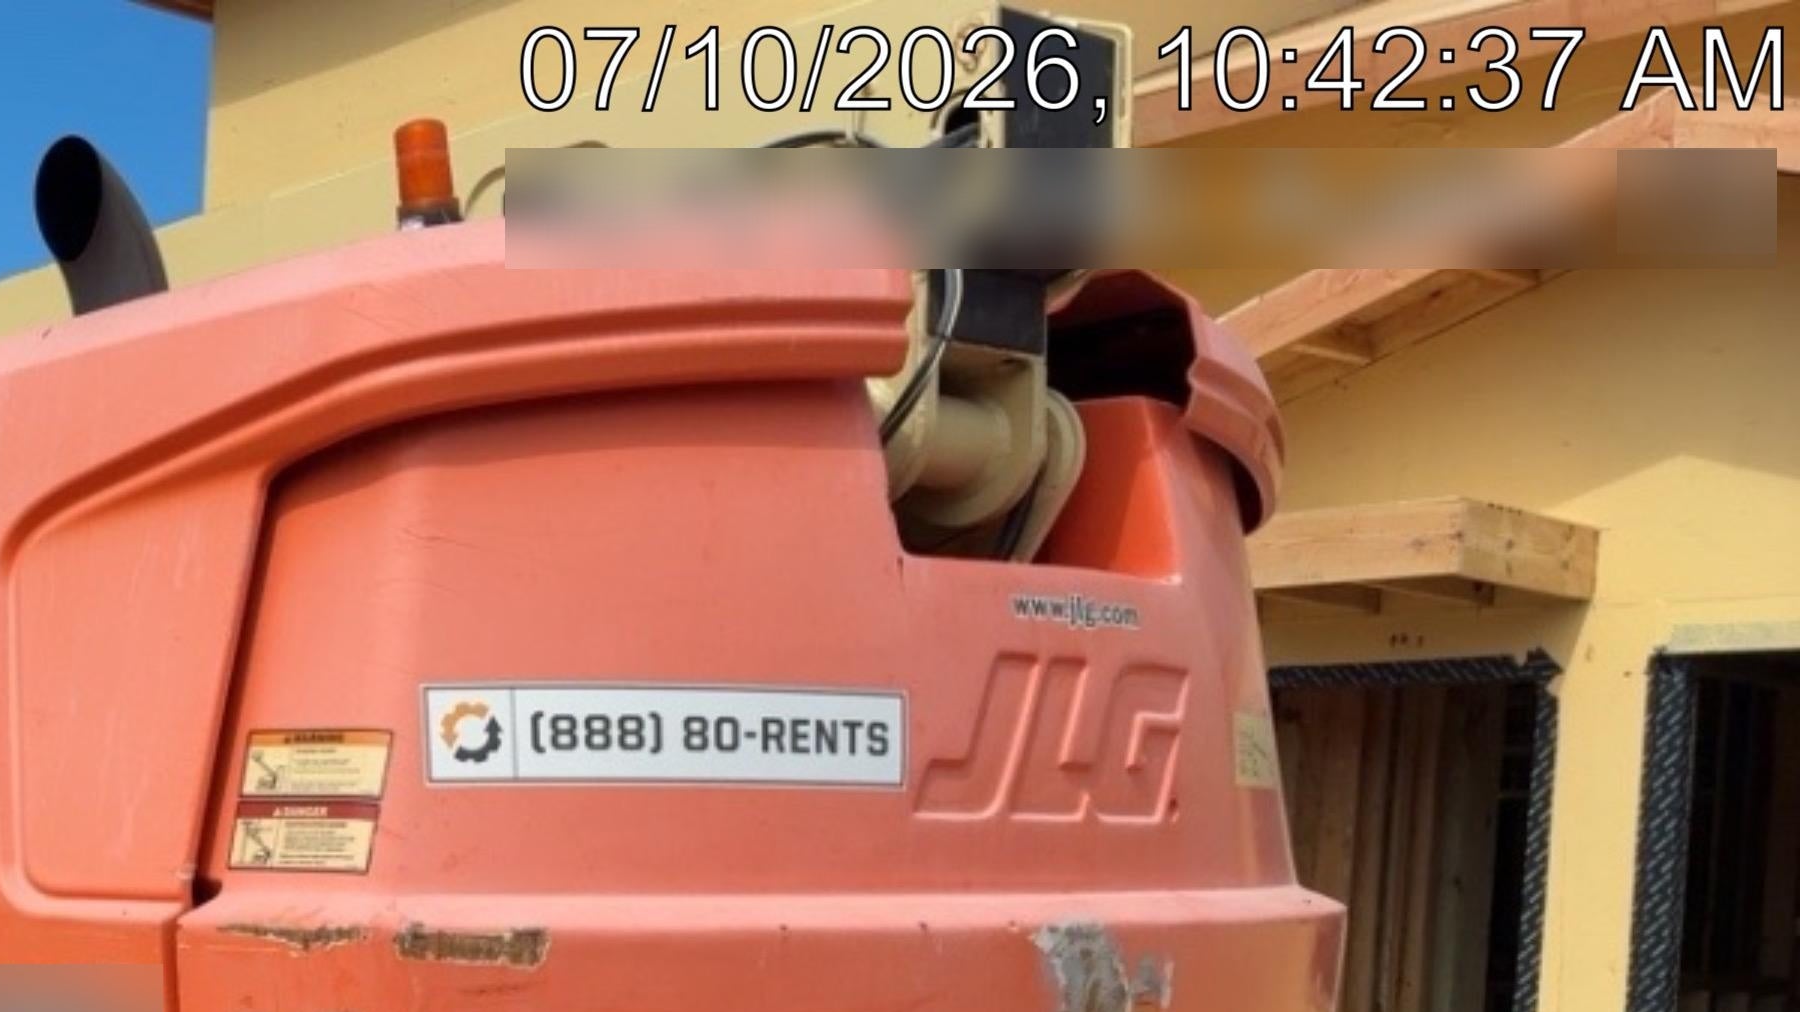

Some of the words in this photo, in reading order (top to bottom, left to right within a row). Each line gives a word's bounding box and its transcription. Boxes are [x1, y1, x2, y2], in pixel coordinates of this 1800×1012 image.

[1013, 595, 1139, 628] www.jlg.com
[530, 711, 664, 755] (888)
[682, 714, 890, 757] 80-RENTS
[912, 649, 1190, 824] JLG
